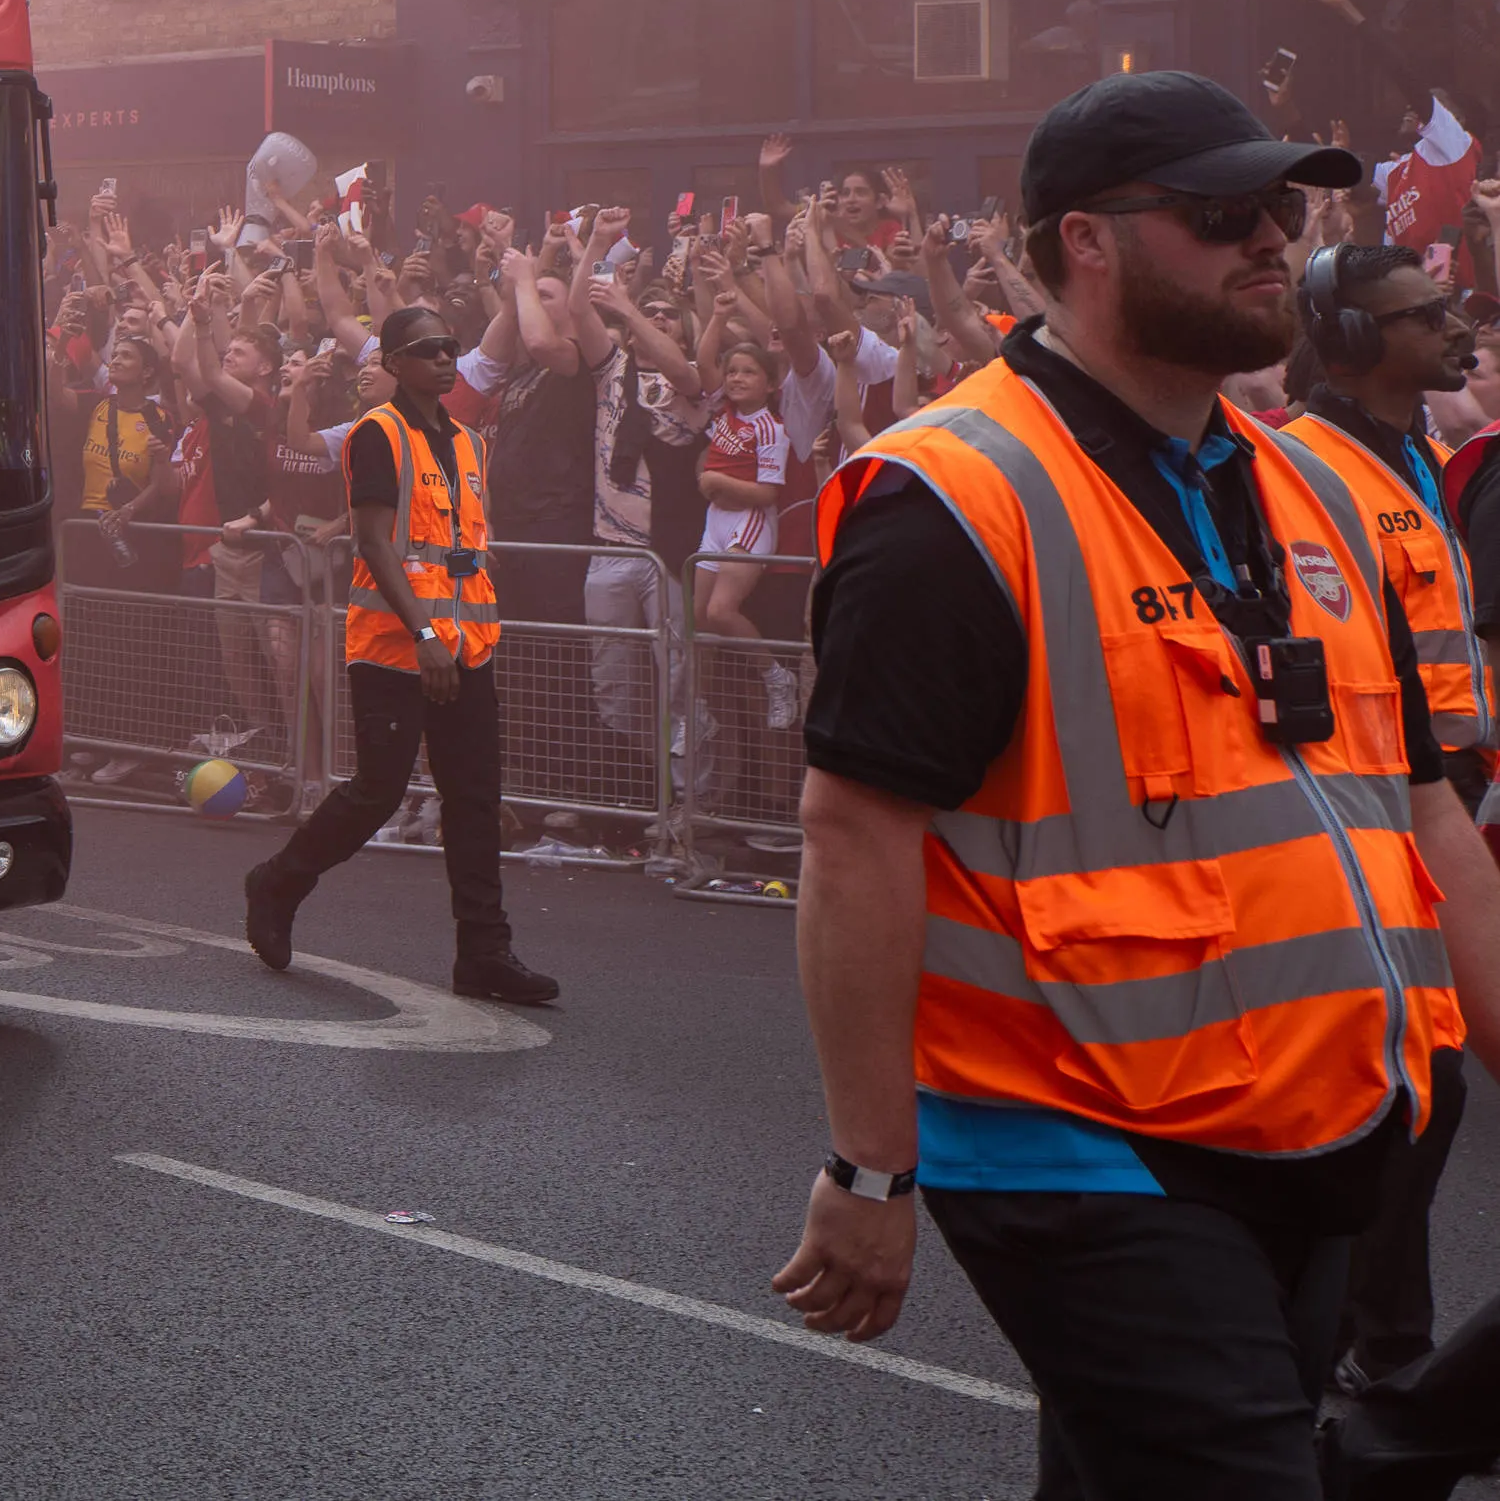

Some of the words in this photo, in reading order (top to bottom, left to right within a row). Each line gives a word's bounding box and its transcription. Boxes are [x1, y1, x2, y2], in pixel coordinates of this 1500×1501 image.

[286, 66, 377, 96] Hamptons
[421, 472, 446, 487] 072
[1377, 509, 1422, 533] 050
[1293, 552, 1338, 569] Arsenal
